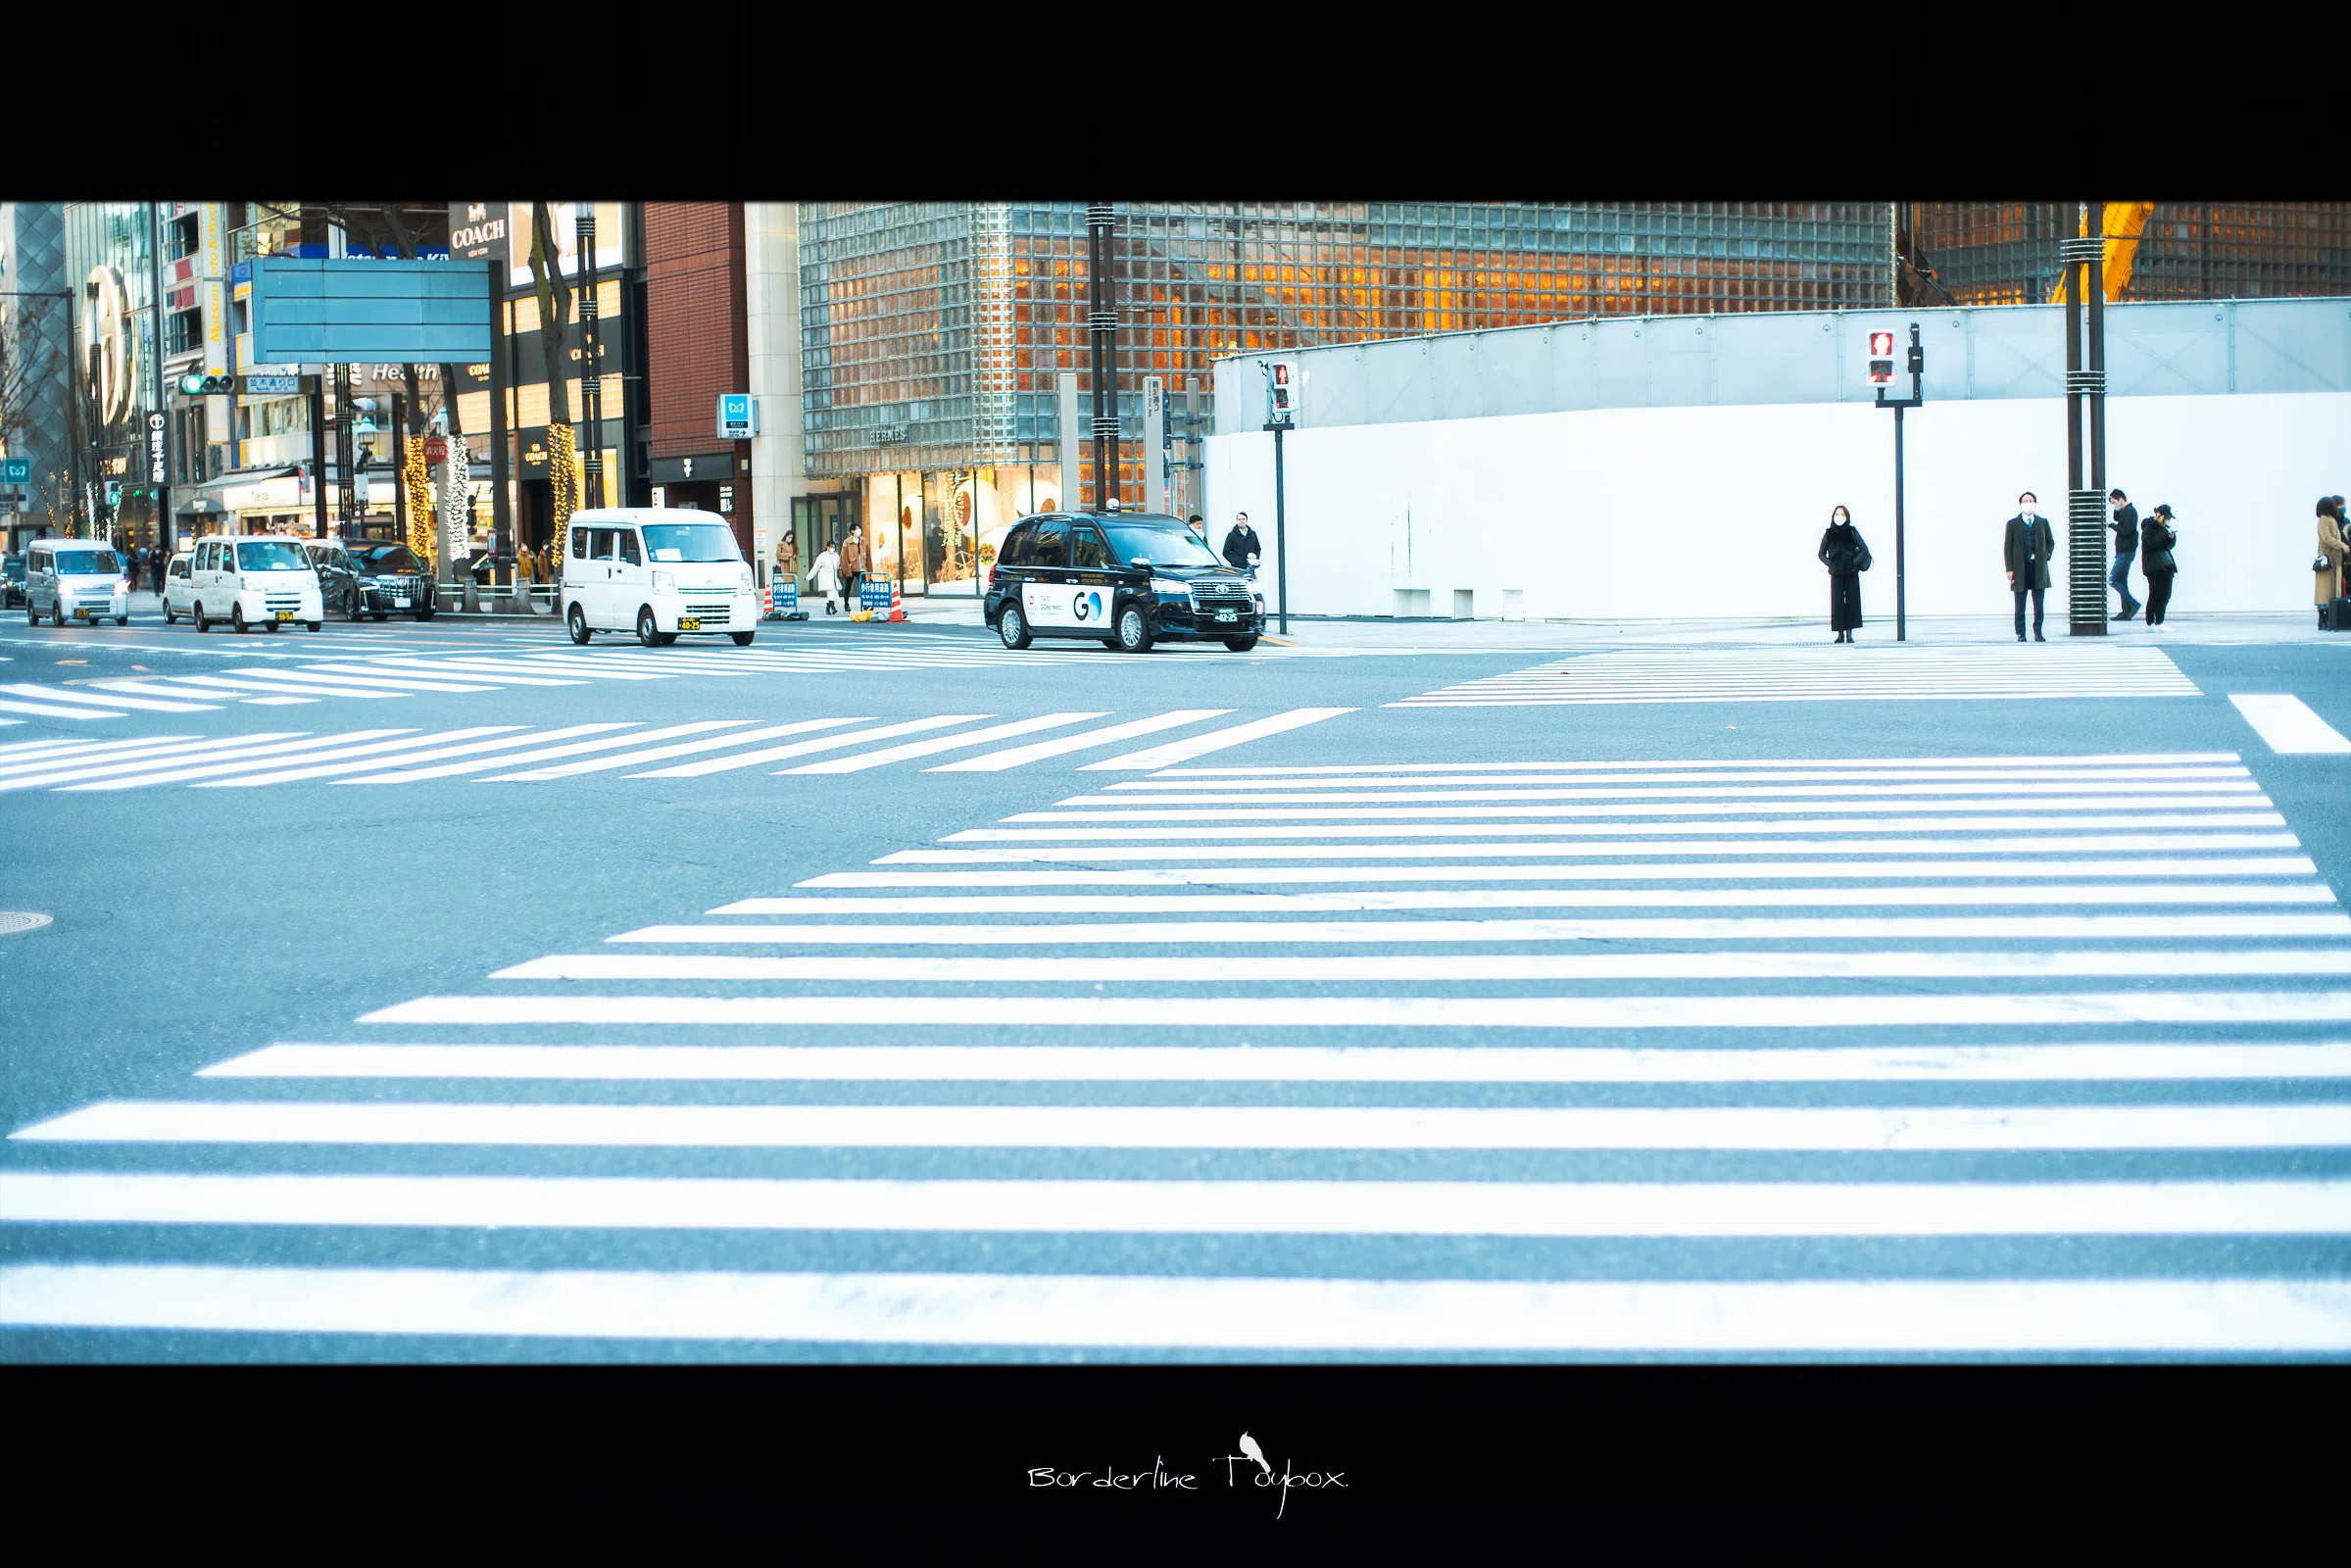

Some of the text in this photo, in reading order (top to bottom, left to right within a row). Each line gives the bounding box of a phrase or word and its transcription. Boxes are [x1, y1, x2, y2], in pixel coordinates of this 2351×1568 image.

[452, 220, 505, 249] COACH
[250, 377, 296, 387] 並木通り口
[681, 621, 701, 630] 40-25
